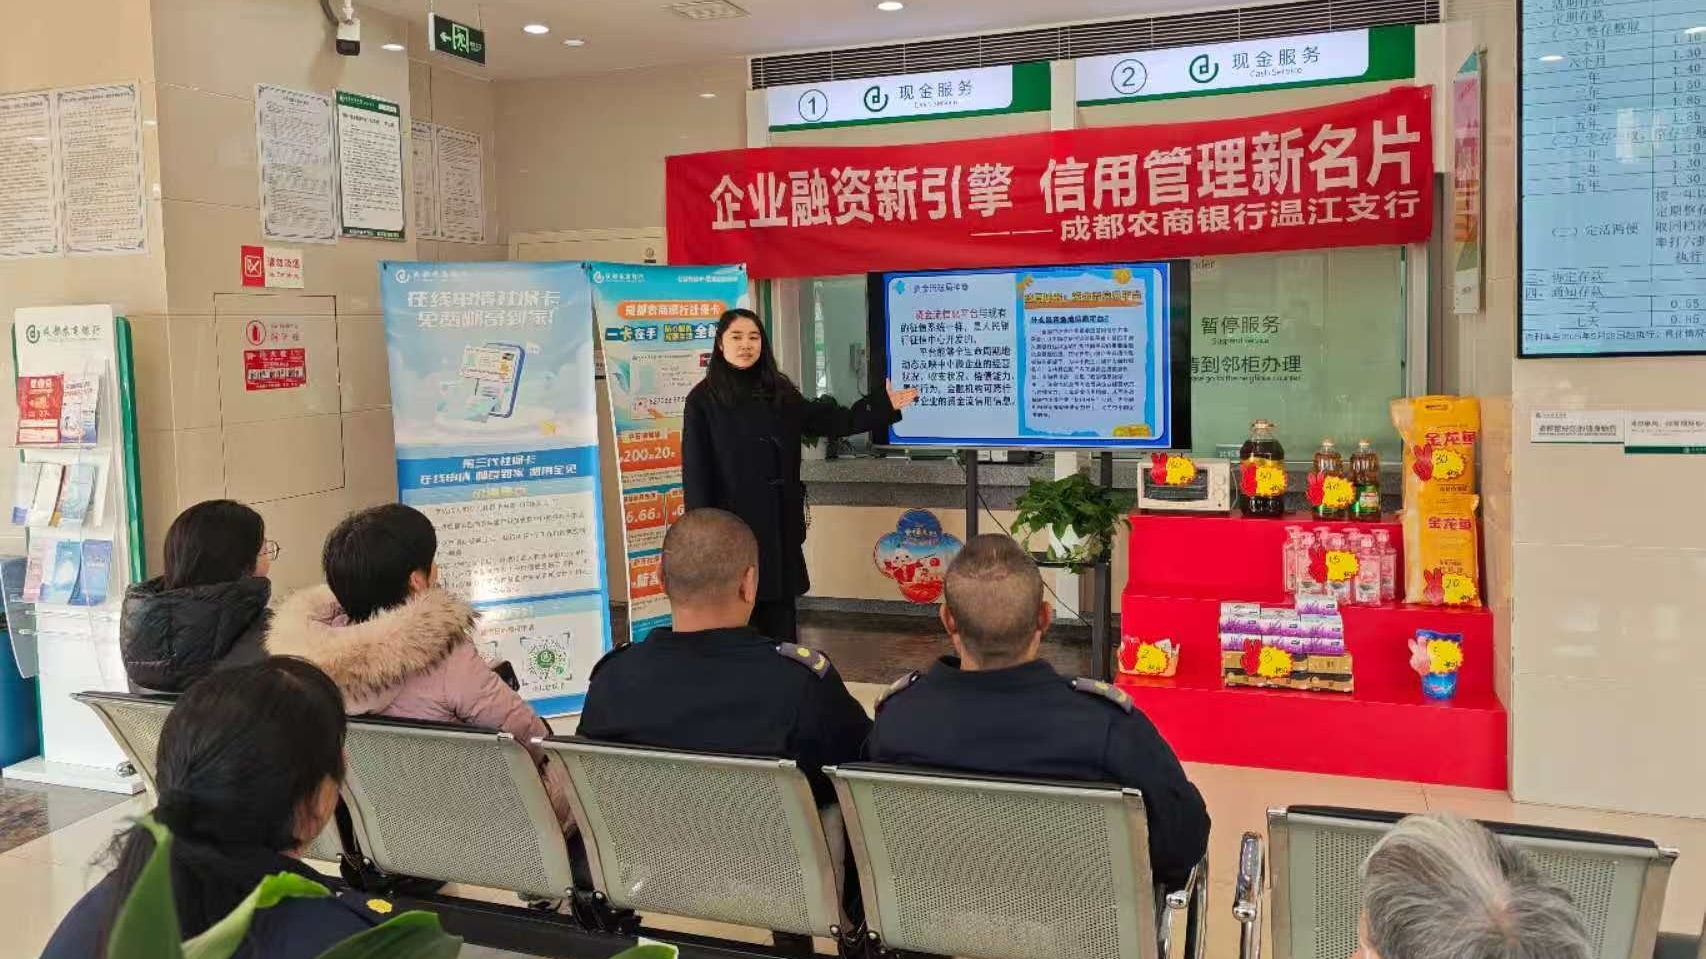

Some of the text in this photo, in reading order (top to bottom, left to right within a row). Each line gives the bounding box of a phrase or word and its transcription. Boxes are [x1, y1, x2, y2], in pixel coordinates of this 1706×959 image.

[1232, 46, 1321, 71] 现金服务
[899, 79, 974, 100] 现金服务
[710, 115, 1421, 230] 企业融资新引擎 信用管理新名片
[606, 325, 657, 341] 一卡在手
[1201, 315, 1281, 335] 暂停服务
